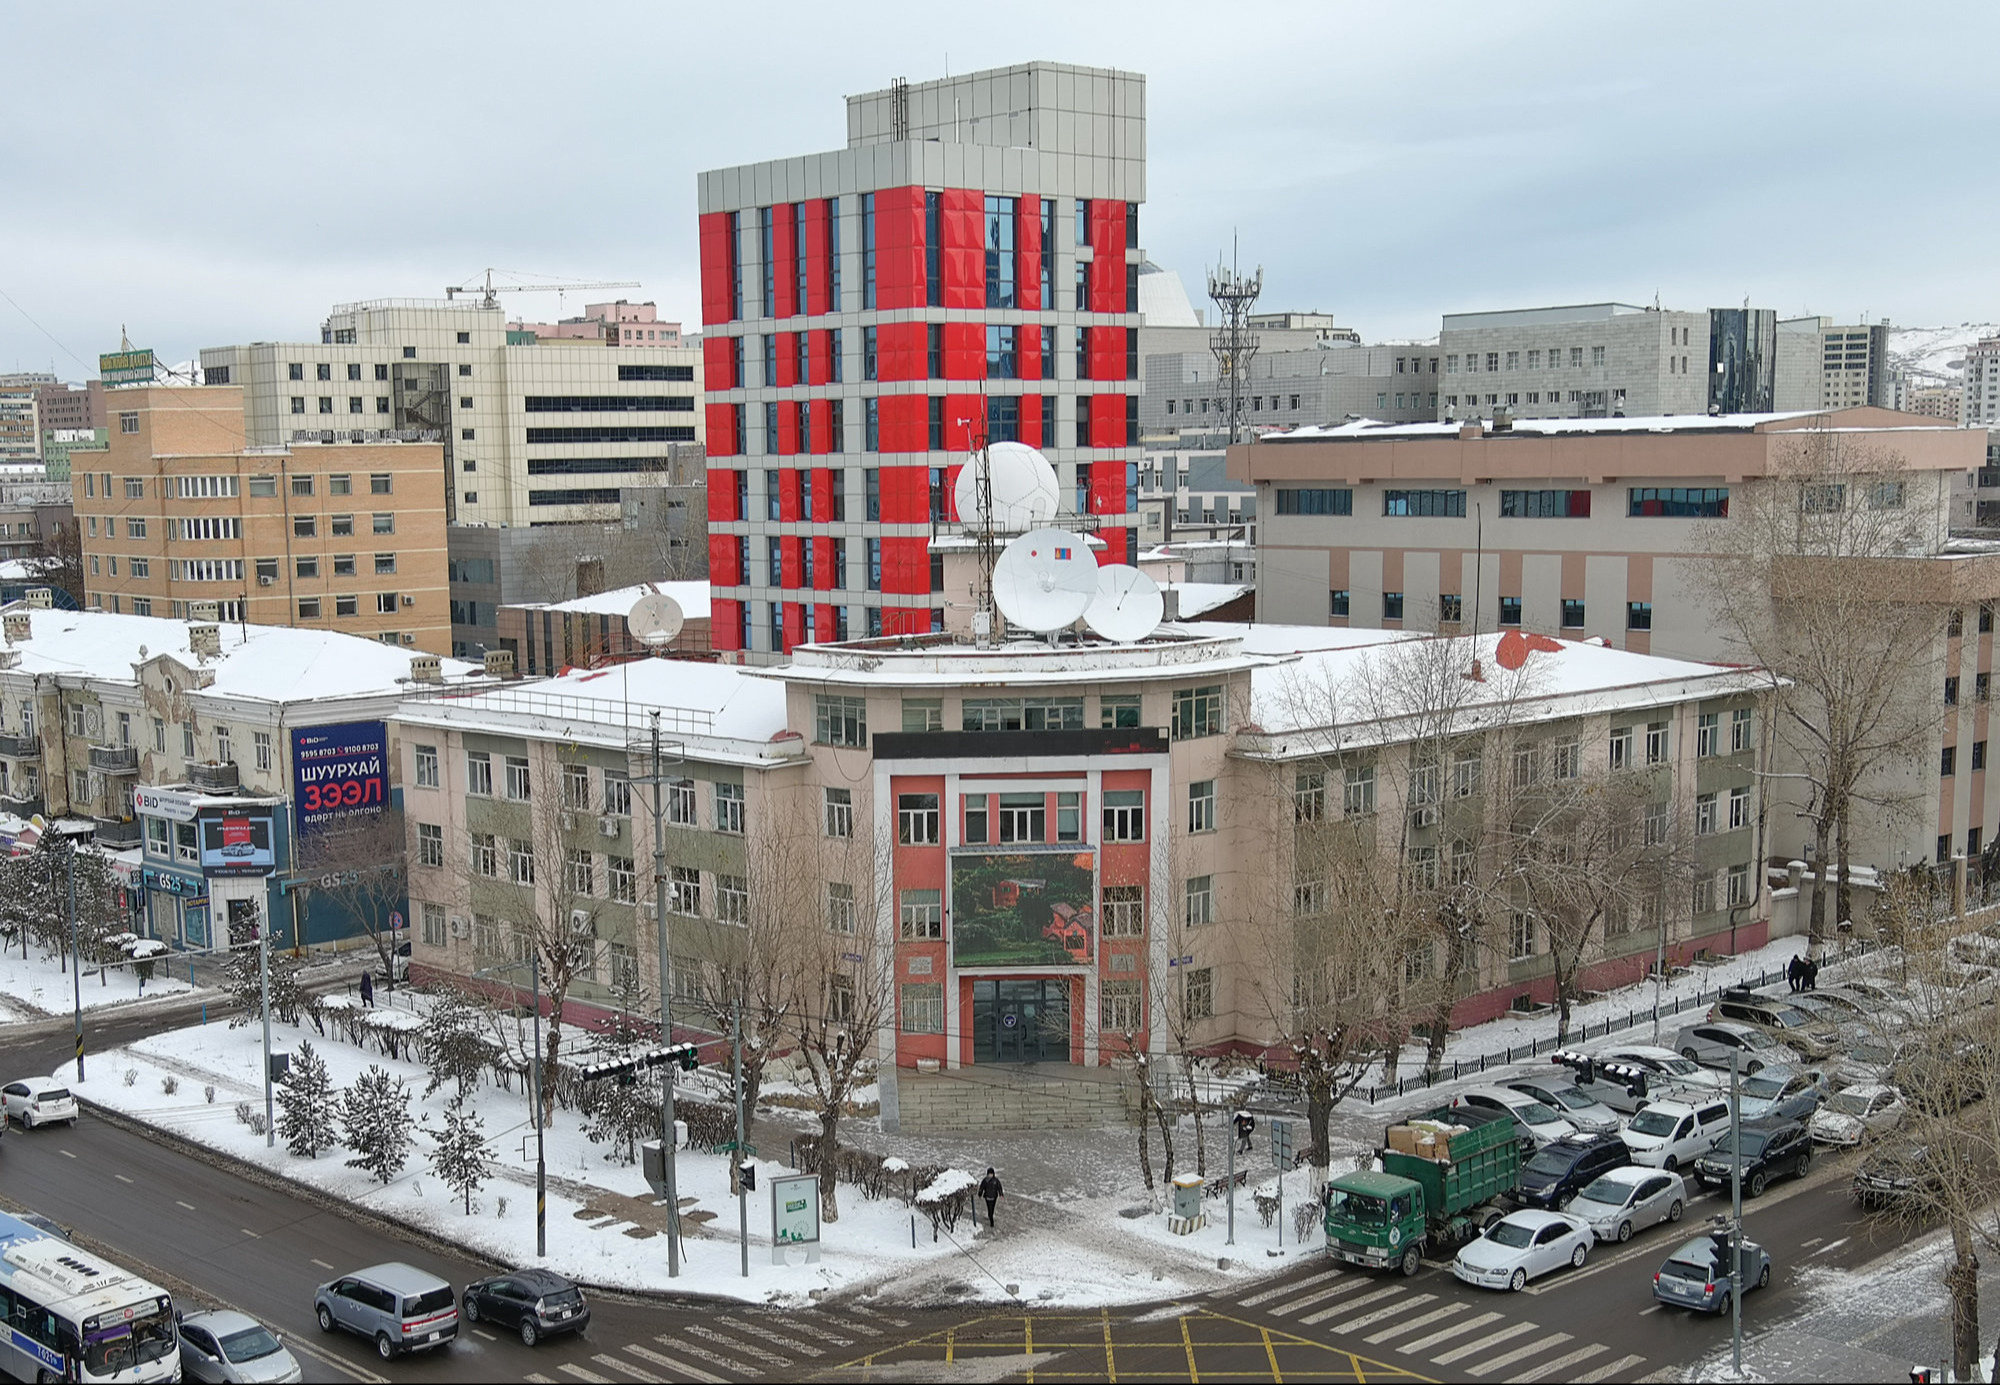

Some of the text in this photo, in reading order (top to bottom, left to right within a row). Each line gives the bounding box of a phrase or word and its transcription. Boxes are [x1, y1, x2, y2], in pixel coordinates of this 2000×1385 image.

[300, 742, 379, 759] 9595 8703 9100 8703
[301, 756, 381, 782] ШУУРХАЙ
[144, 795, 159, 809] BID
[304, 777, 382, 811] ЗЭЭЛ
[304, 812, 334, 823] өдөрт
[348, 805, 382, 817] олгоно
[159, 872, 181, 892] GS25
[320, 871, 359, 888] GS25
